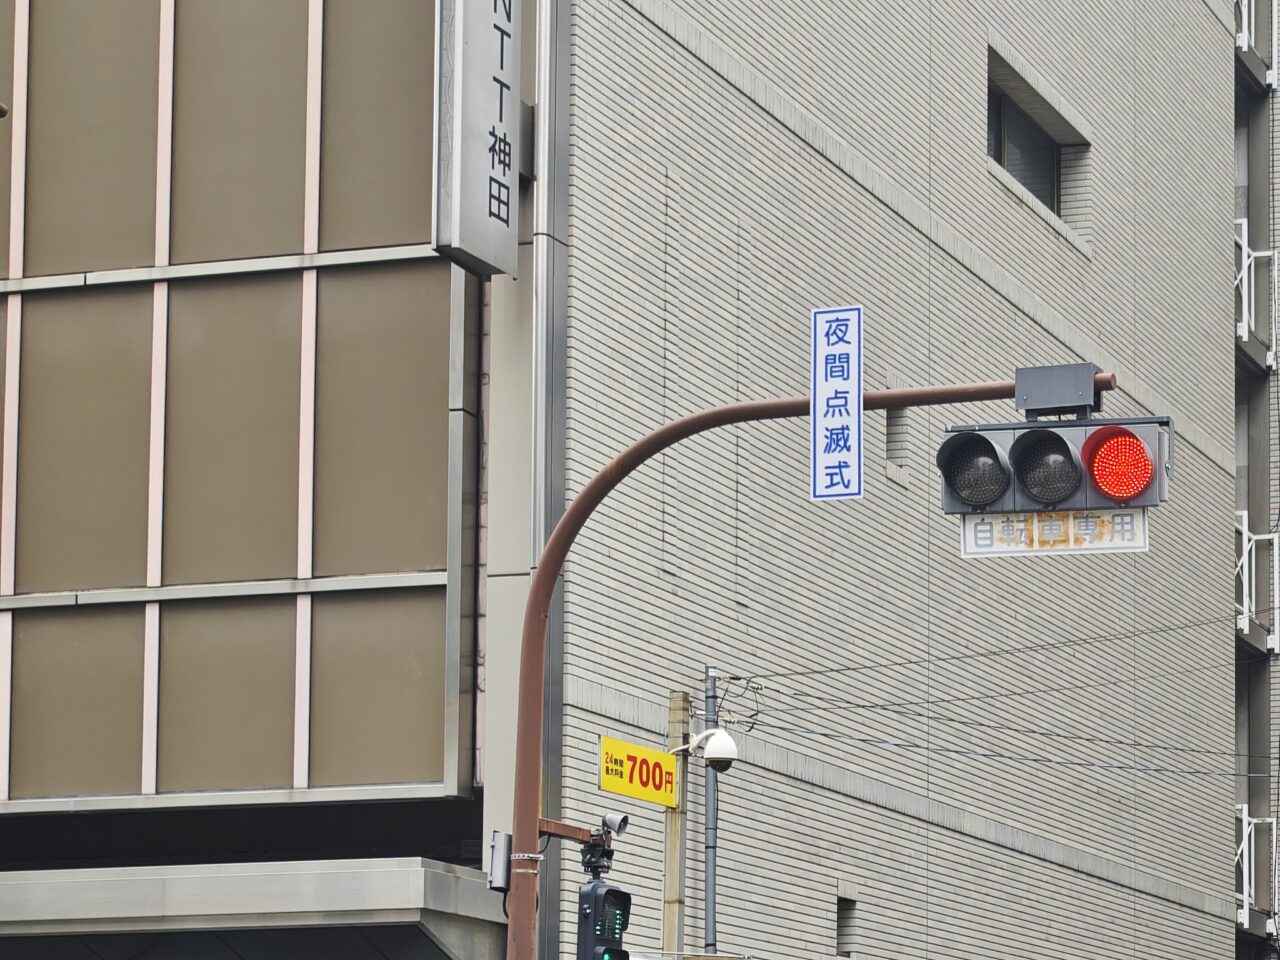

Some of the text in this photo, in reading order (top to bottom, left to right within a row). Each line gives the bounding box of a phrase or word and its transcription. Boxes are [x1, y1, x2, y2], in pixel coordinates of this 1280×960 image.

[823, 316, 852, 490] 夜間点滅式
[973, 513, 1136, 548] 自転車専用
[626, 754, 674, 795] 700円
